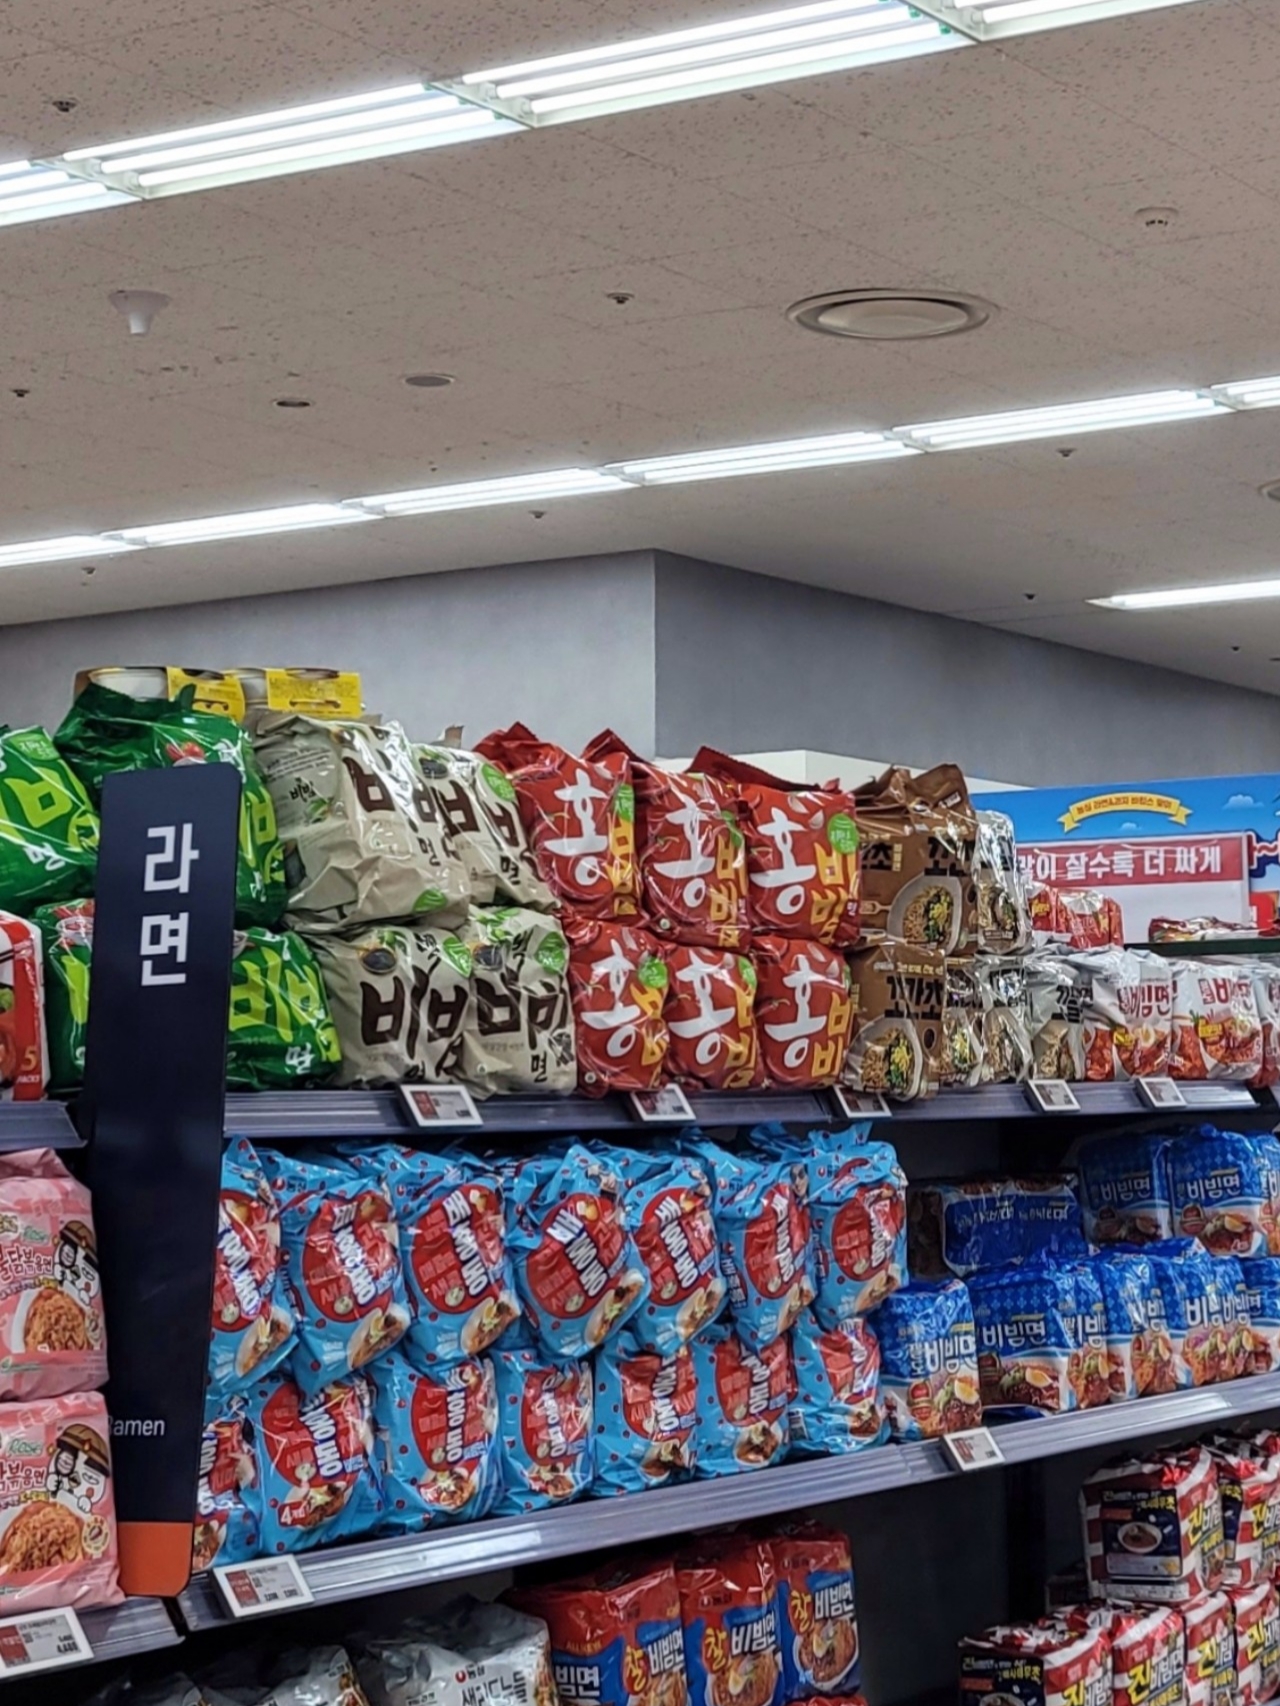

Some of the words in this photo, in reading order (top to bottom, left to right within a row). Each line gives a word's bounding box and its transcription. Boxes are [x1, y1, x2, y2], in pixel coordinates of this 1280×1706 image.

[749, 806, 818, 916] 홍
[1065, 848, 1134, 880] 살수록
[1143, 847, 1165, 876] 더
[1173, 845, 1222, 874] 싸게
[139, 822, 200, 988] 라면
[667, 948, 736, 1066] 홍
[764, 954, 827, 1069] 홍
[1185, 1172, 1242, 1200] 비빔면
[981, 1316, 1047, 1348] 비빔면
[790, 1590, 812, 1633] 찰
[814, 1579, 855, 1620] 비빔면
[704, 1627, 727, 1673] 찰
[731, 1610, 776, 1656] 비빔면
[1128, 1661, 1151, 1705] 진
[1150, 1646, 1185, 1691] 비빔면
